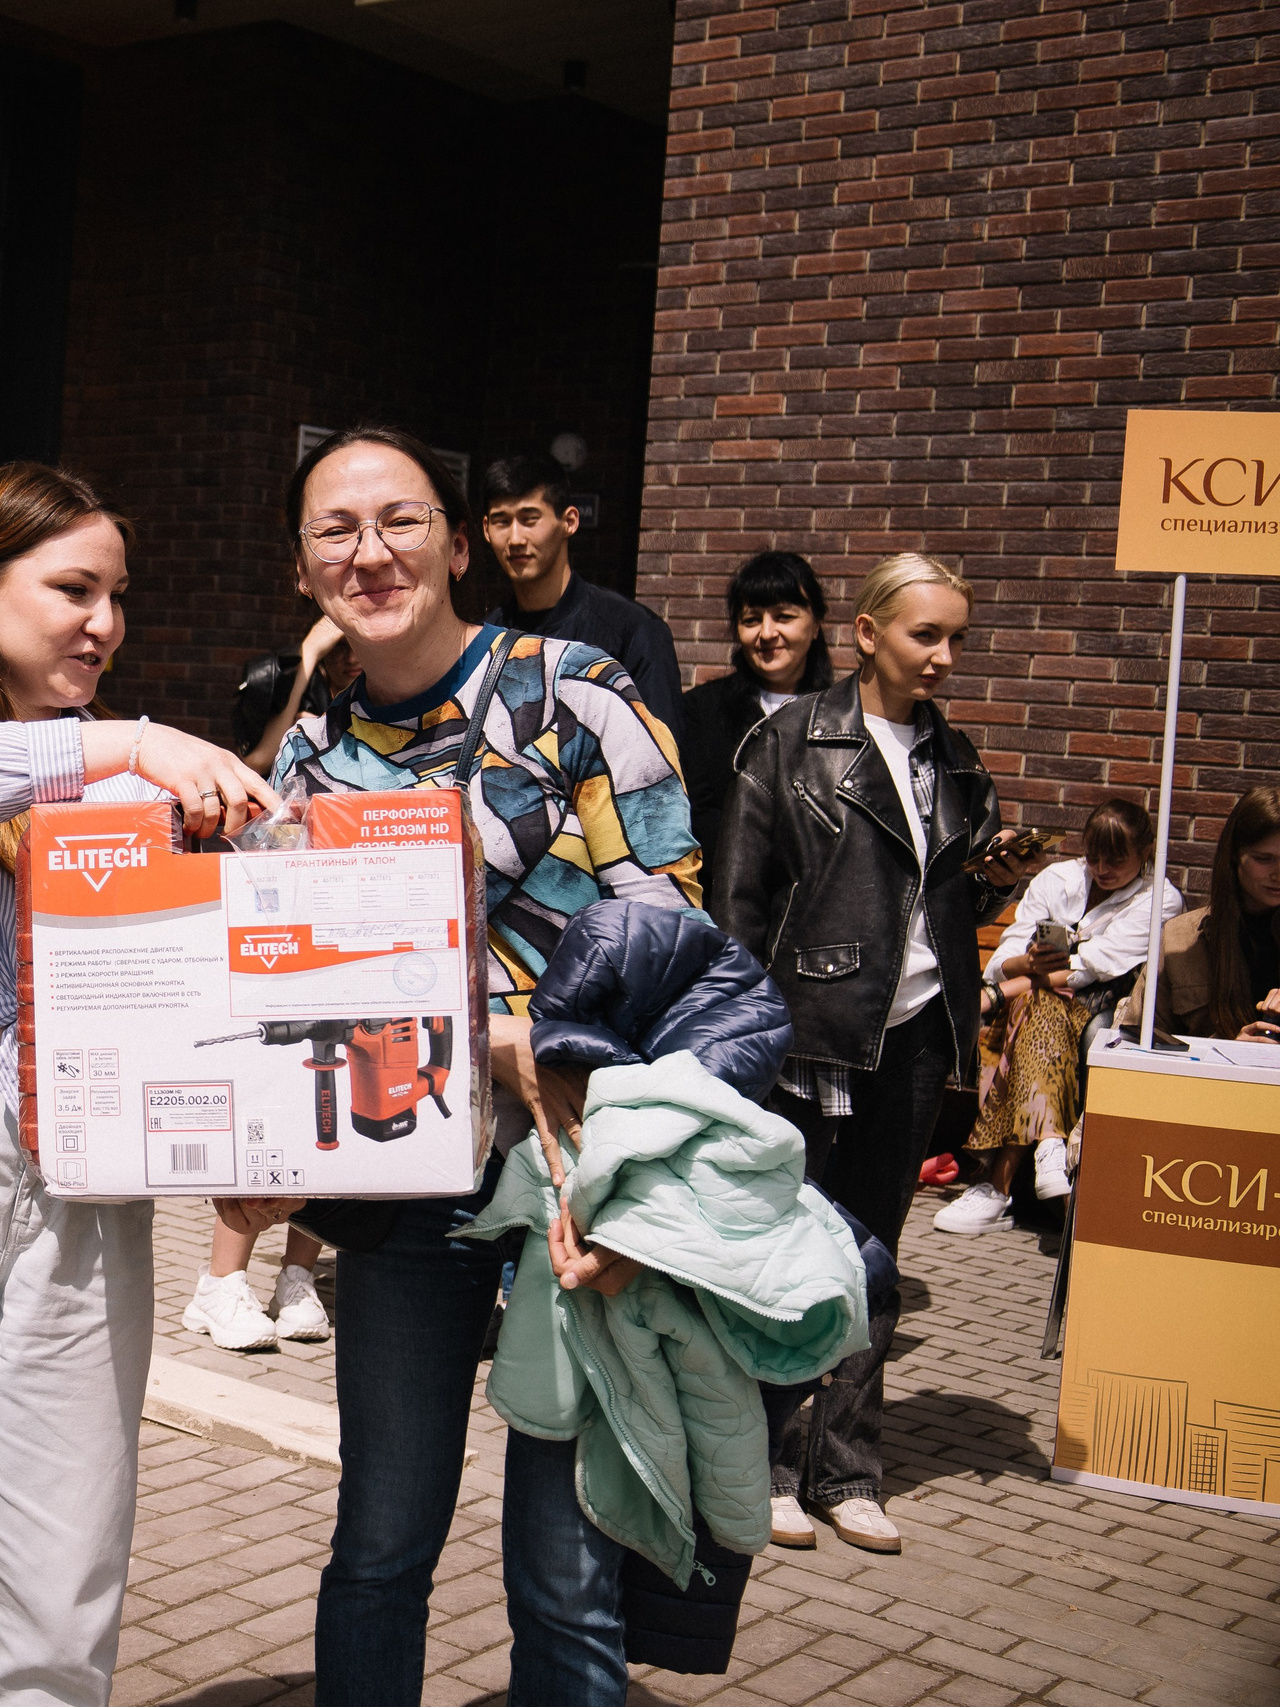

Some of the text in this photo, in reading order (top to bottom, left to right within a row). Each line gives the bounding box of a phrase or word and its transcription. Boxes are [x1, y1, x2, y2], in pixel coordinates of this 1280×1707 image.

[1161, 517, 1280, 535] специализ
[363, 807, 449, 821] ПЕРФОРАТОР
[360, 823, 450, 837] П 1130ЭМ HD
[48, 847, 148, 871] ELITECH
[285, 856, 396, 869] ГАРАНТИЙНЫЙ ТАЛОН
[55, 949, 100, 957] ВЕРТИКАЛЬНОЕ
[240, 942, 299, 956] ELITECH
[115, 958, 150, 966] (СВЕРЛЕНИЕ
[185, 955, 218, 963] ОТБОЙНЫЙ
[56, 992, 104, 1000] СВЕТОДИОДНЫЙ
[106, 992, 141, 1000] ИНДИКАТОР
[388, 1083, 412, 1094] ELITECH
[150, 1095, 227, 1106] E2205.002.00
[71, 1104, 83, 1112] Дж
[322, 1090, 332, 1133] ELITECH
[1142, 1210, 1280, 1240] специализир
